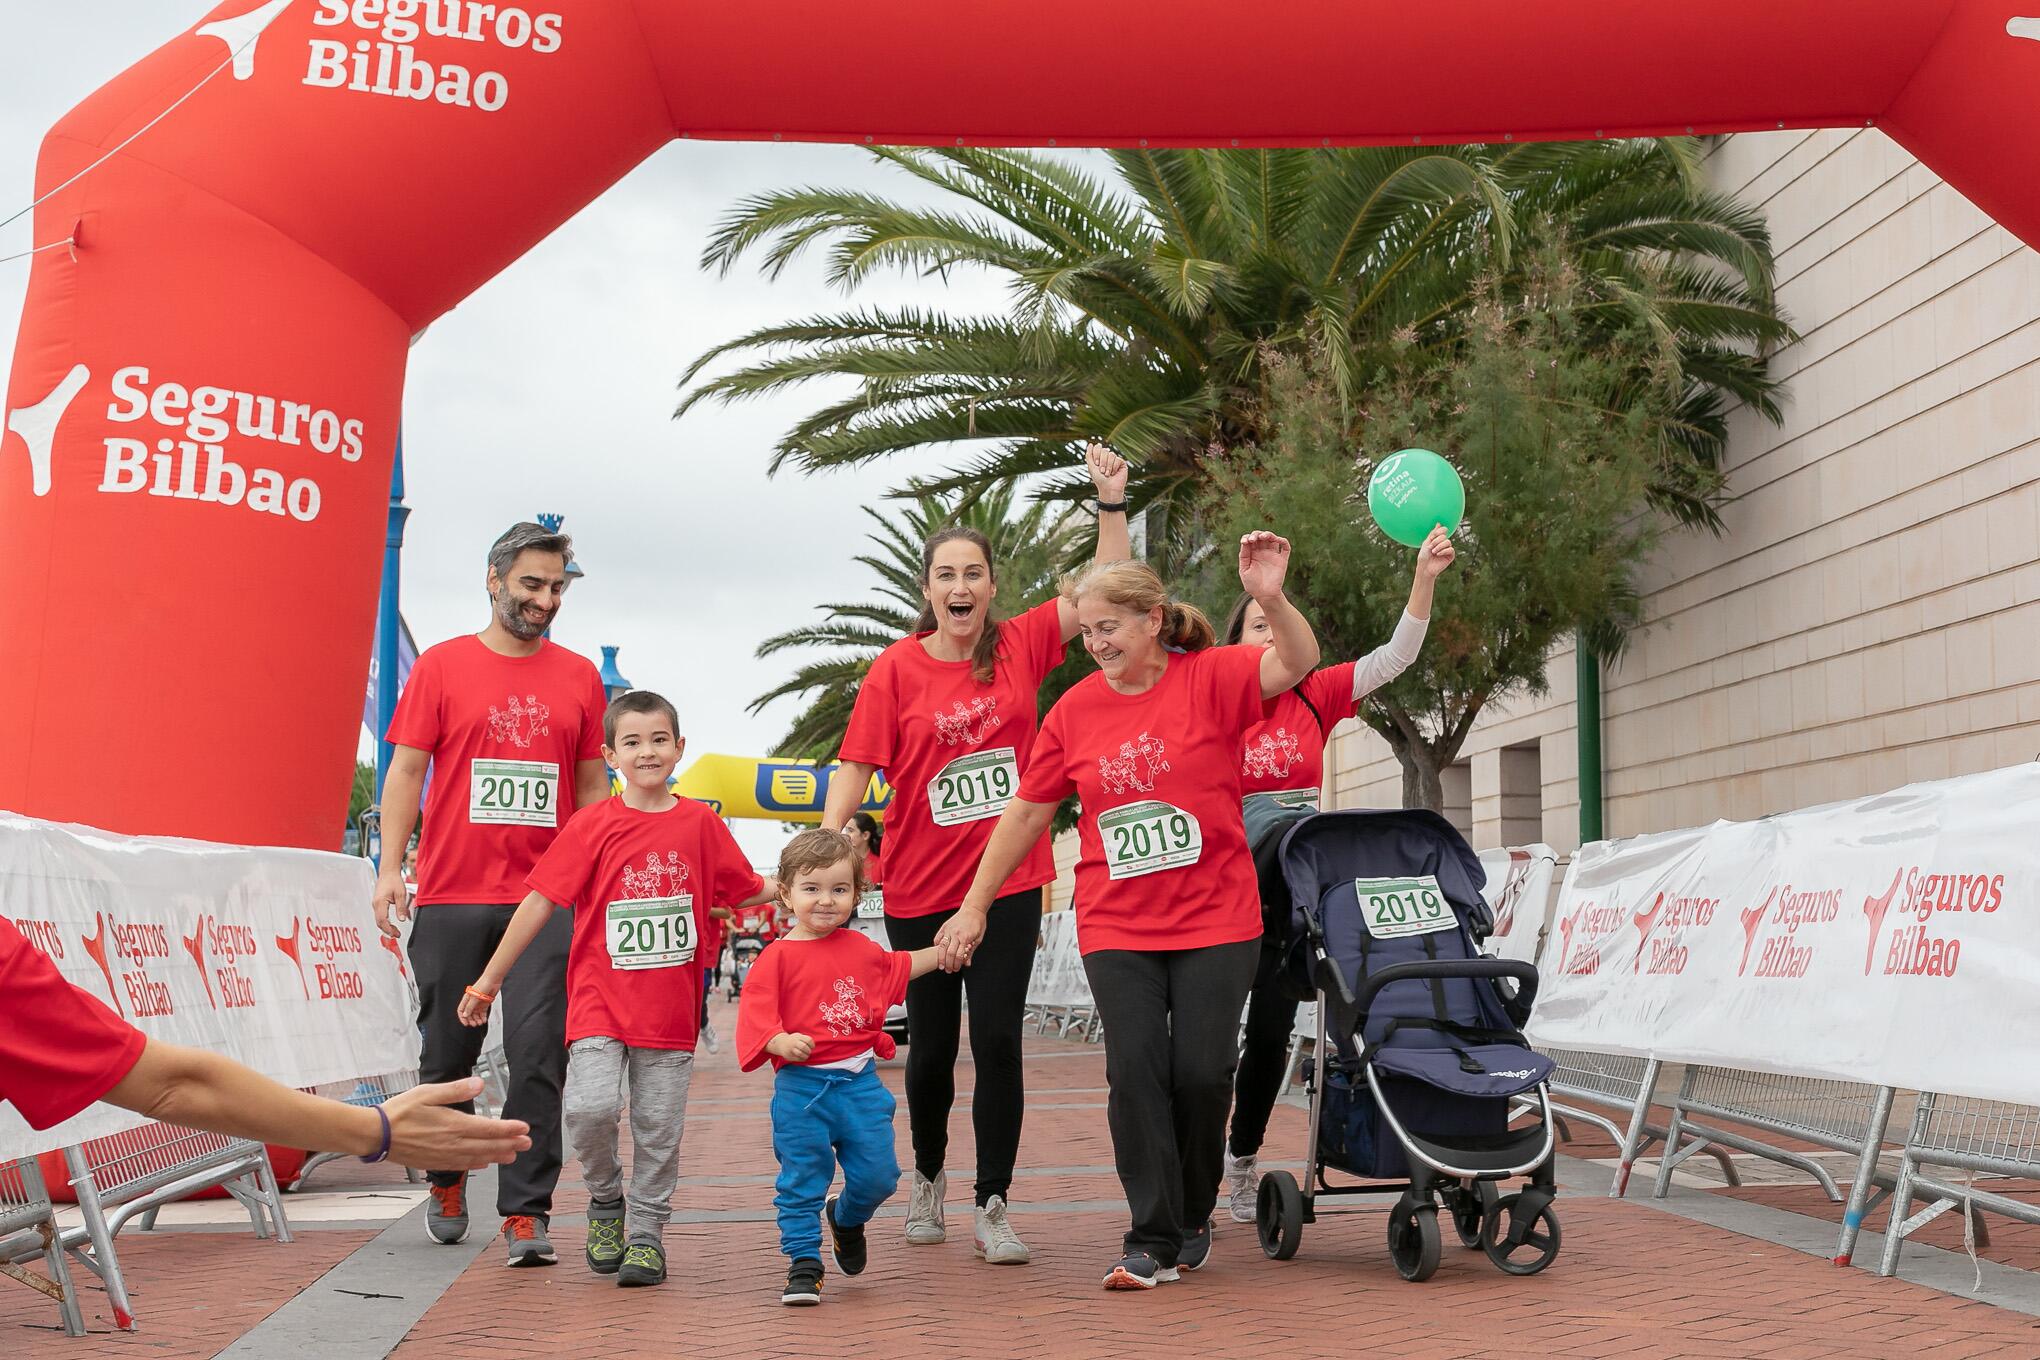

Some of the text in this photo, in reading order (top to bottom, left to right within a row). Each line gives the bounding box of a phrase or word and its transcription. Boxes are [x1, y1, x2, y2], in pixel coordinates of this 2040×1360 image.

[302, 39, 509, 111] Bilbao
[107, 366, 364, 462] Seguros
[98, 437, 321, 522] Bilbao
[1382, 471, 1410, 498] retina
[480, 777, 549, 810] 2019
[938, 766, 1011, 809] 2019
[1114, 814, 1191, 861] 2019
[1369, 890, 1441, 923] 2019
[1772, 885, 1842, 933] Seguros
[1899, 866, 2004, 922] Seguros
[108, 913, 169, 968] Seguros
[207, 914, 257, 965] Seguros
[306, 916, 362, 960] Seguros
[617, 915, 689, 953] 2019
[1754, 936, 1813, 978] Bilbao
[1884, 925, 1961, 977] Bilbao
[122, 970, 174, 1018] Bilbao
